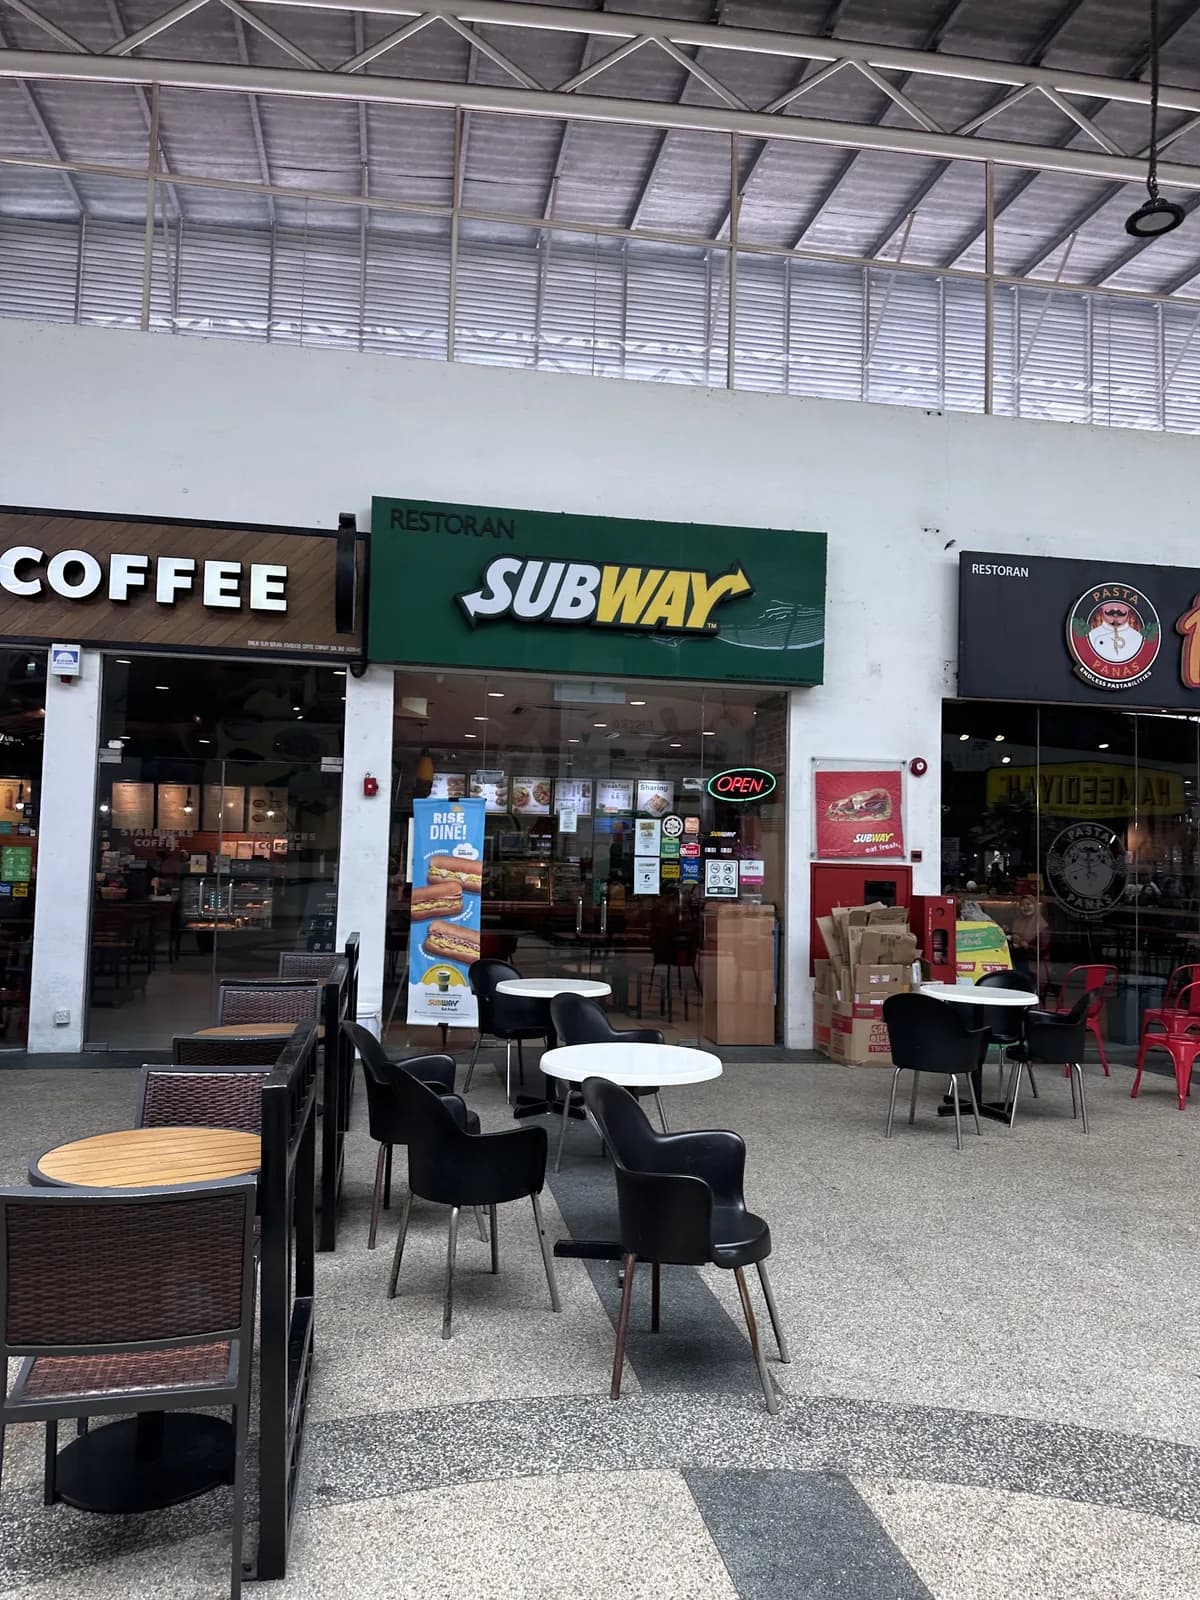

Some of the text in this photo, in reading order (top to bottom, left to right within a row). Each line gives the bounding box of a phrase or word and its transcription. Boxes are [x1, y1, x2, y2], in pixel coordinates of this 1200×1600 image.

[389, 508, 515, 539] RESTORAN
[0, 546, 288, 612] COFFEE
[971, 563, 1029, 578] RESTORAN
[462, 557, 752, 629] SUBWAY
[1092, 587, 1139, 605] PASTA
[1092, 659, 1141, 677] PANAS
[1079, 667, 1153, 689] ENDLESS PASTABILITIES
[640, 784, 669, 793] Sharing
[717, 776, 763, 793] OPEN
[433, 812, 465, 824] RISE
[430, 825, 467, 840] DINE!
[853, 833, 894, 843] SUBWAY
[1068, 828, 1110, 842] PASTA
